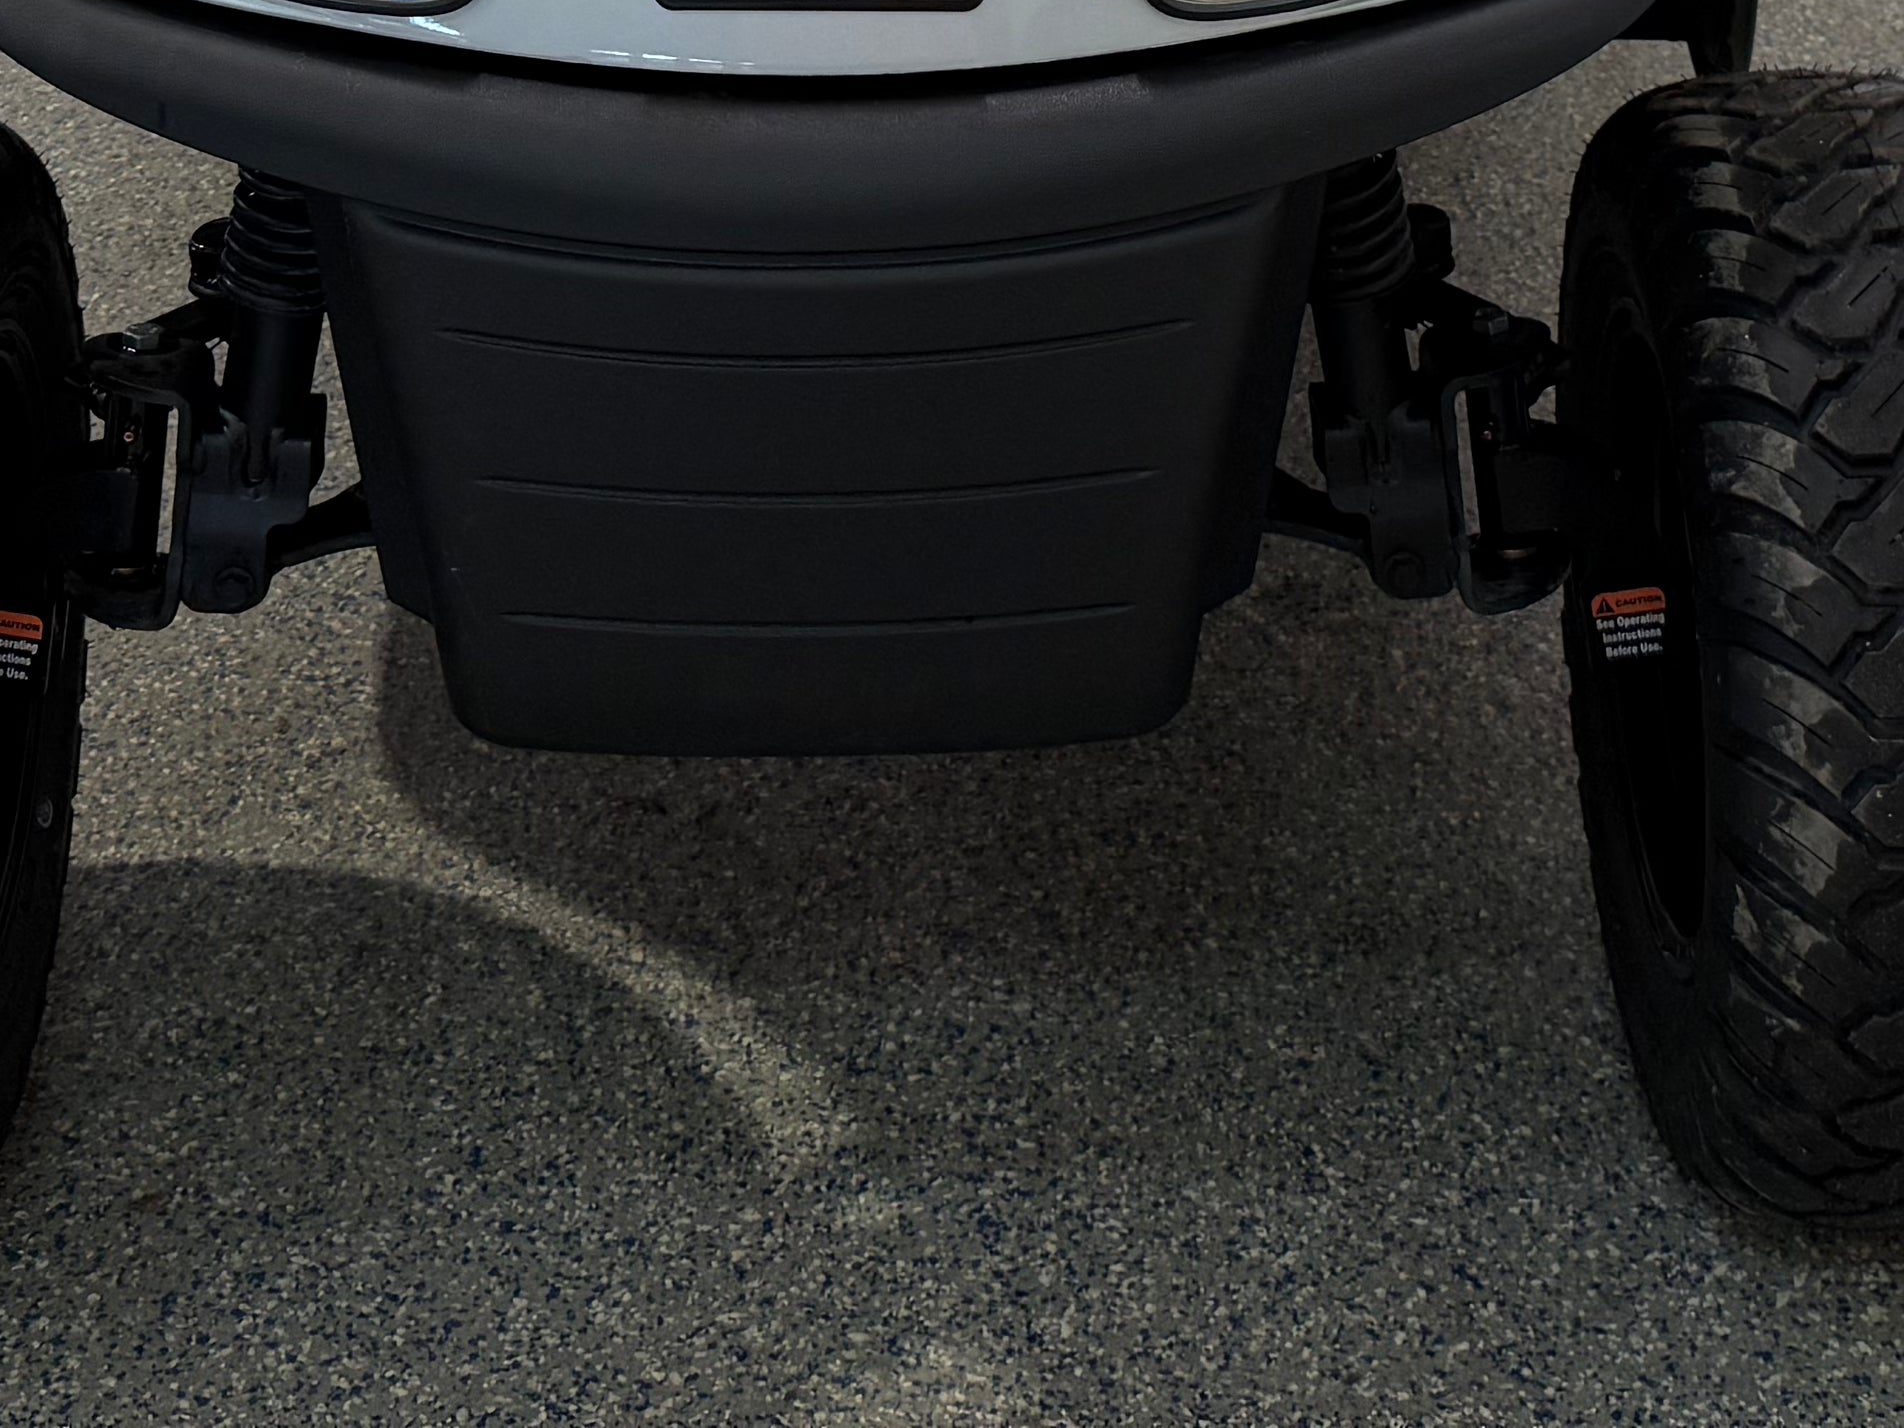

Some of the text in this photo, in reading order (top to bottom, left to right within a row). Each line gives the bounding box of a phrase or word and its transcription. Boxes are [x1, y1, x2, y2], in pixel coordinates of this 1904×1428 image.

[1615, 594, 1663, 608] CAUTION
[1595, 612, 1666, 631] See Operating
[1602, 628, 1662, 644] Instructions
[1605, 642, 1663, 658] Before Use.
[6, 667, 29, 681] Use.
